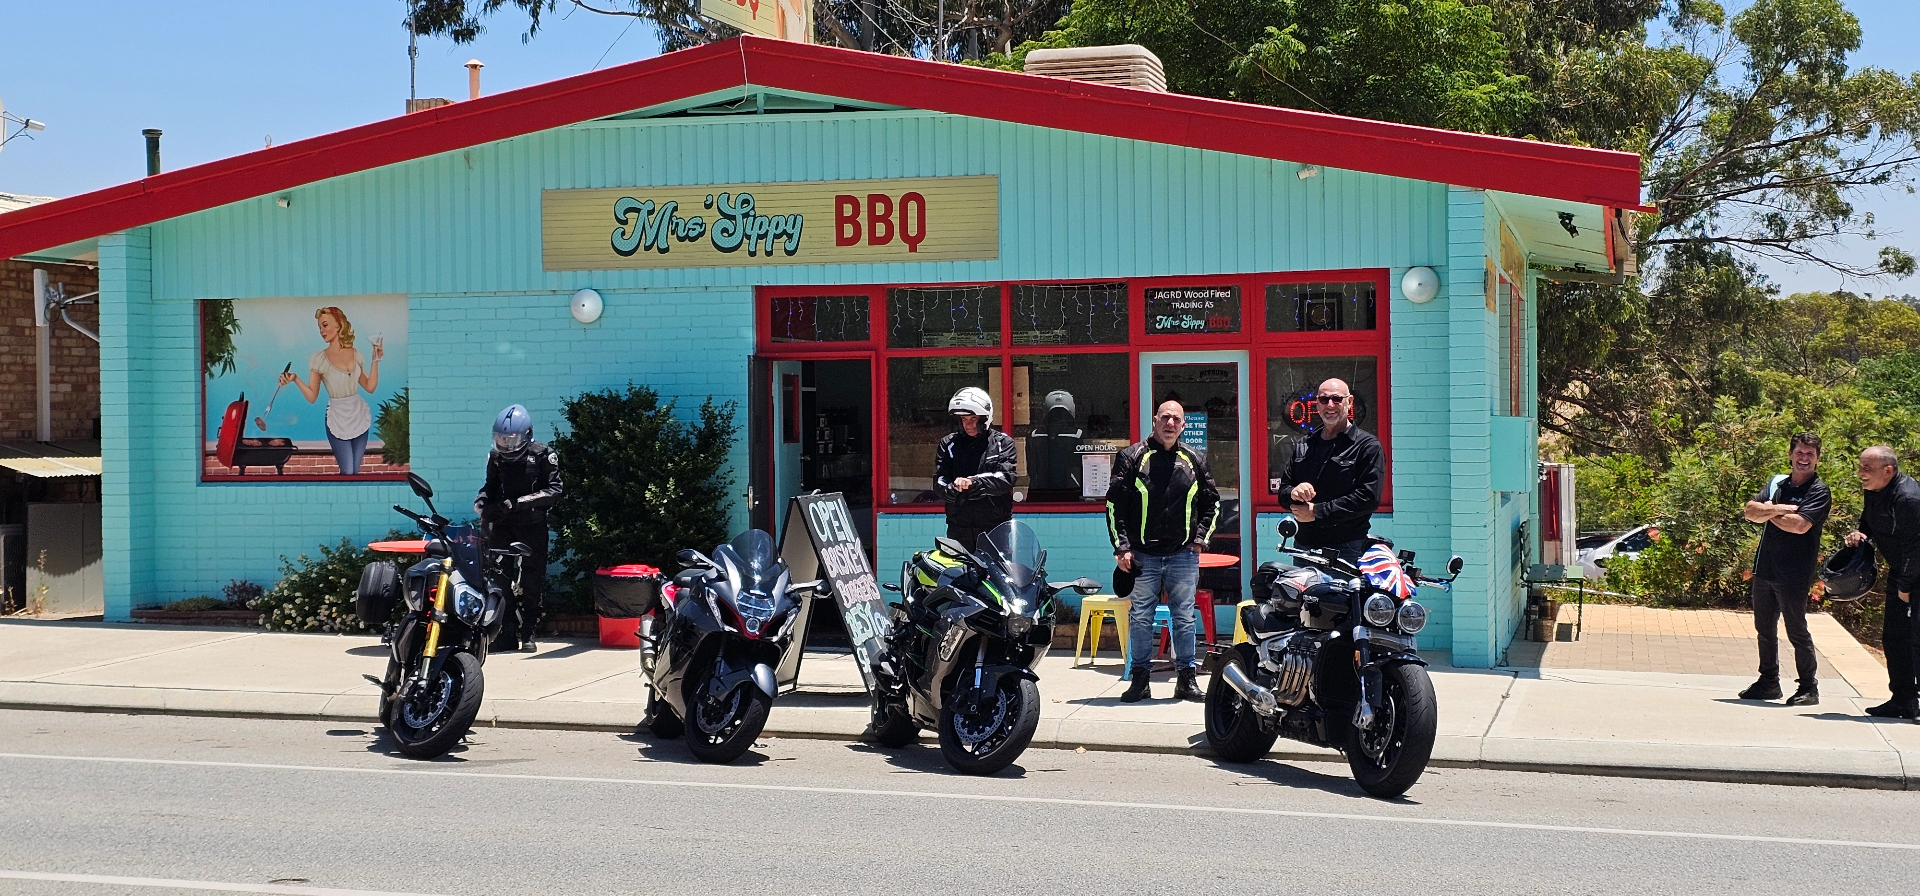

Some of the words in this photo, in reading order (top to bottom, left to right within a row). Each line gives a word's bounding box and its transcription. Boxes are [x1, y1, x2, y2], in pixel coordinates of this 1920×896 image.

[835, 192, 927, 253] BBQ
[1154, 291, 1182, 299] JAGRD
[1184, 290, 1209, 298] Wood
[1210, 290, 1231, 298] Fired
[1209, 316, 1230, 330] BBQ
[808, 498, 856, 543] OPEN
[821, 537, 869, 578] BRISKET
[845, 601, 879, 646] BEST
